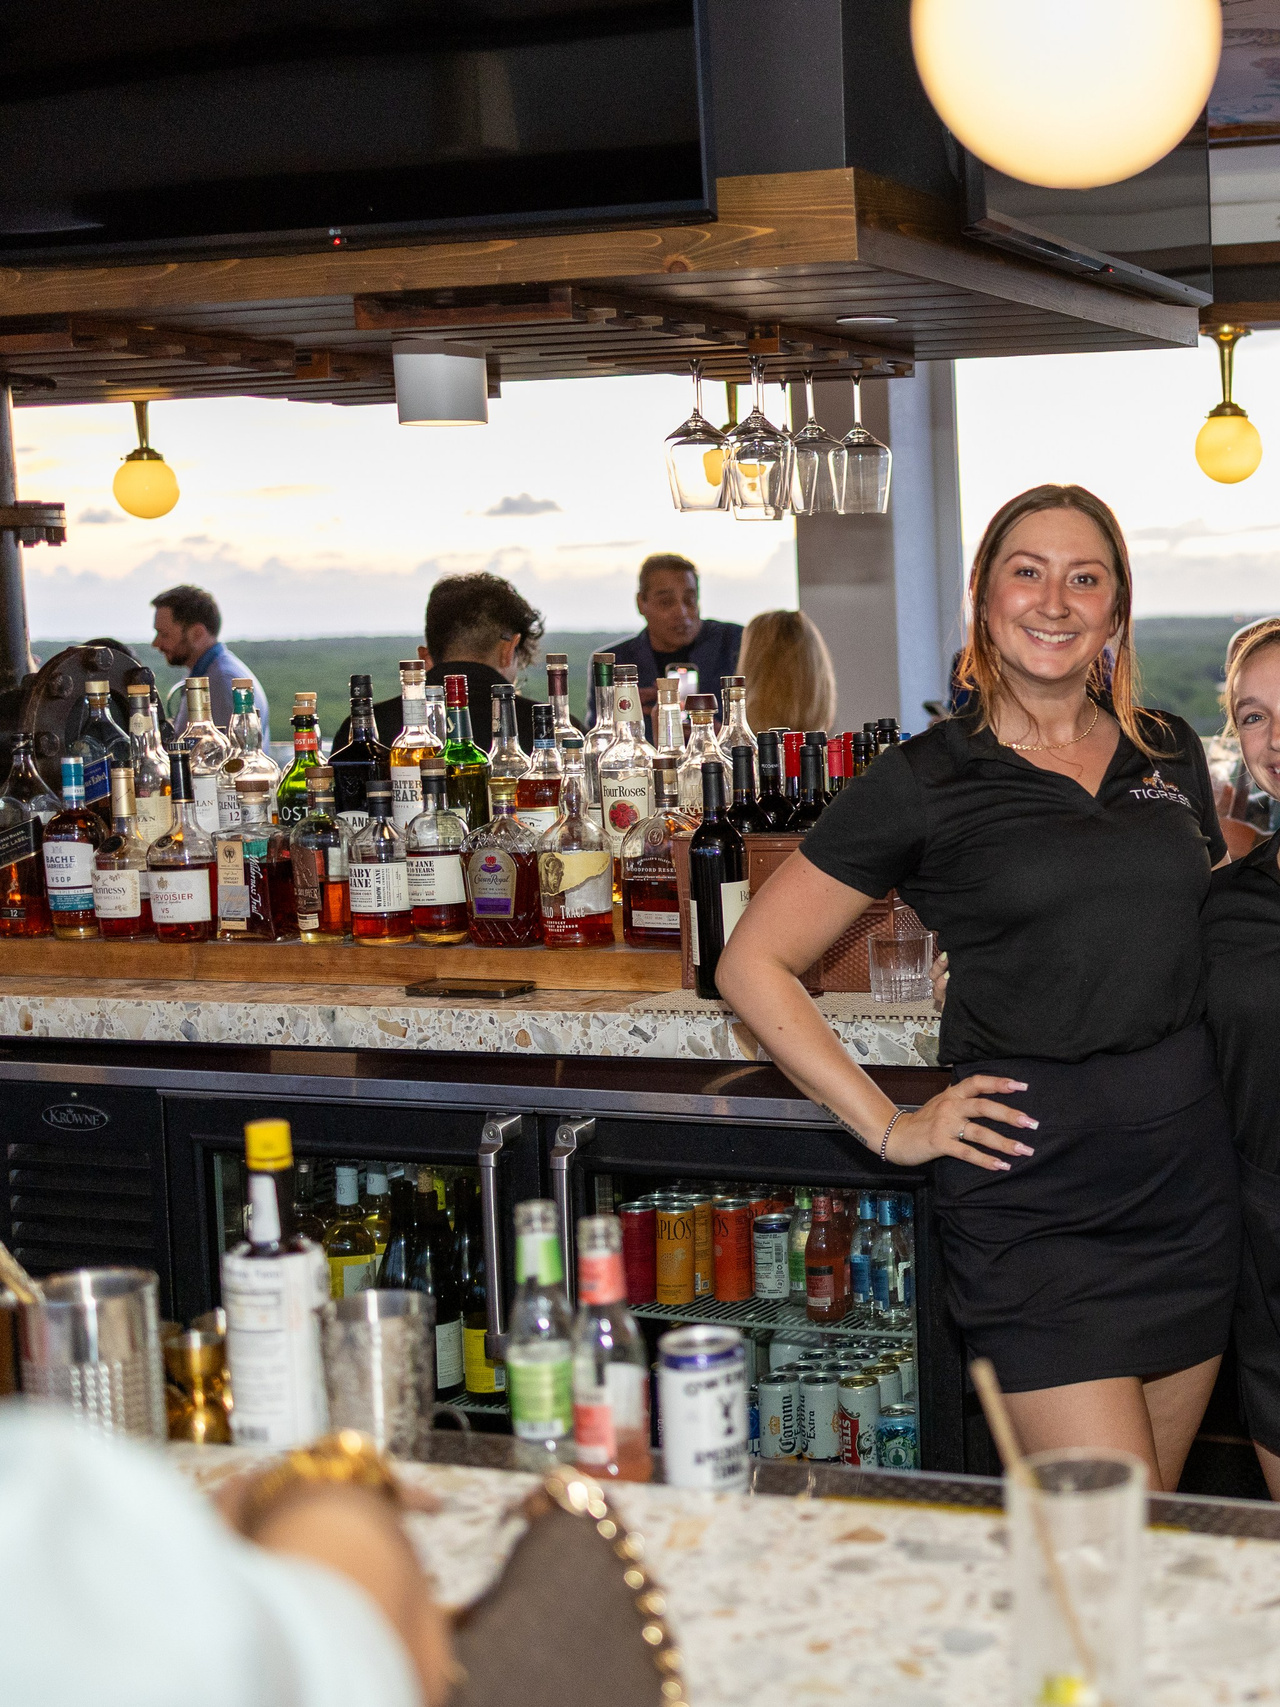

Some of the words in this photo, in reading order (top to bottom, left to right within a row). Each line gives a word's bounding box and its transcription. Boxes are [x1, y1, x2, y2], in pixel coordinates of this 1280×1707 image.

[603, 786, 618, 798] Four
[618, 785, 646, 797] Roses
[350, 868, 371, 878] BABY
[9, 909, 18, 917] 12
[49, 1108, 101, 1126] KROWNE
[779, 1394, 797, 1454] Corona
[807, 1410, 816, 1440] Extra
